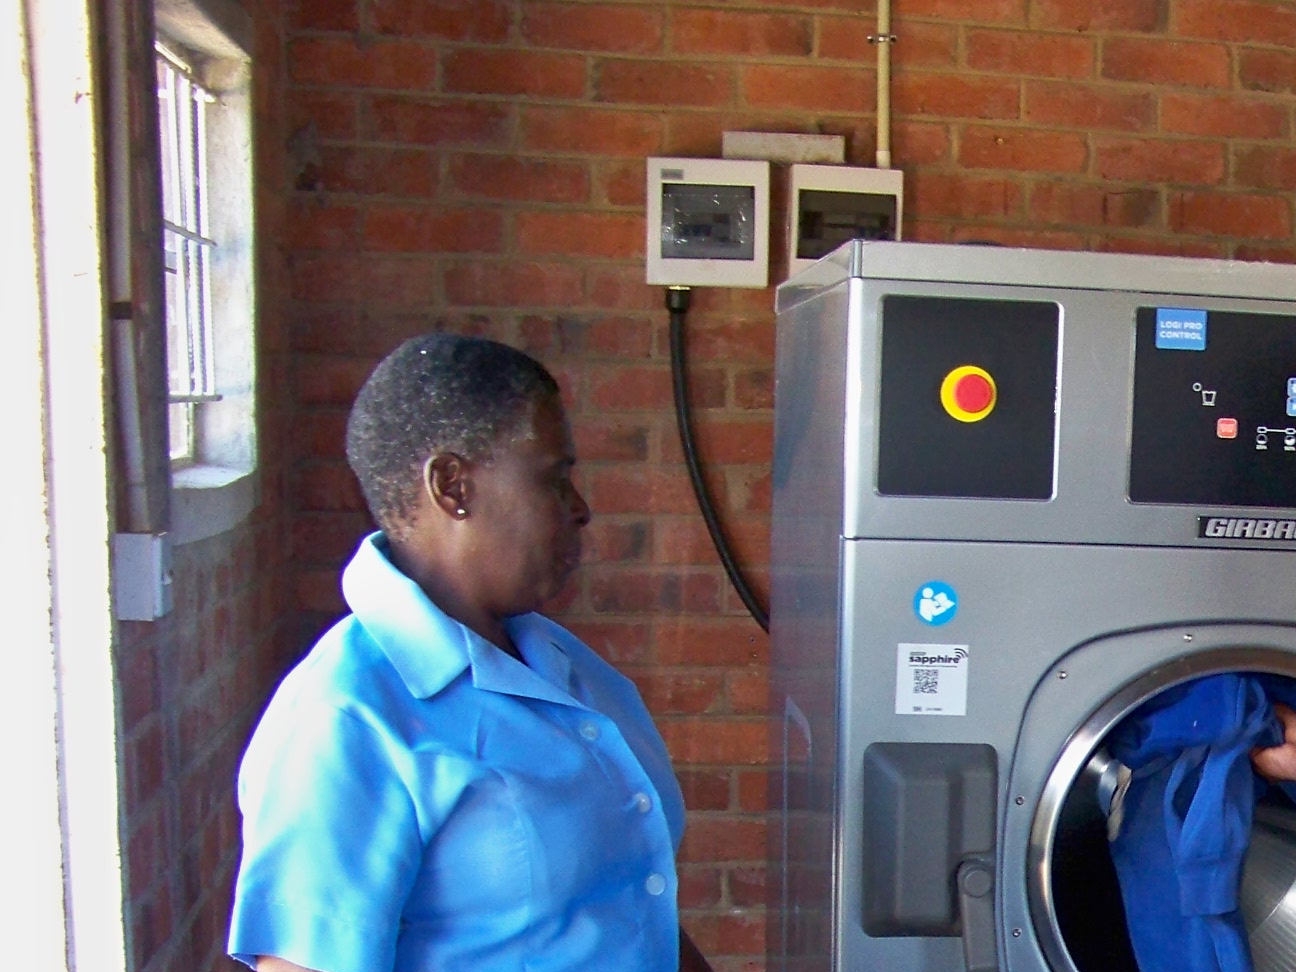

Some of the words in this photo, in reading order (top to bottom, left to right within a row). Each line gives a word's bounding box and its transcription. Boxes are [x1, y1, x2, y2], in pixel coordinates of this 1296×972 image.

[1160, 321, 1182, 329] LOGI
[1183, 322, 1203, 330] PRO
[1160, 331, 1202, 340] CONTROL
[909, 655, 959, 664] sapphire
